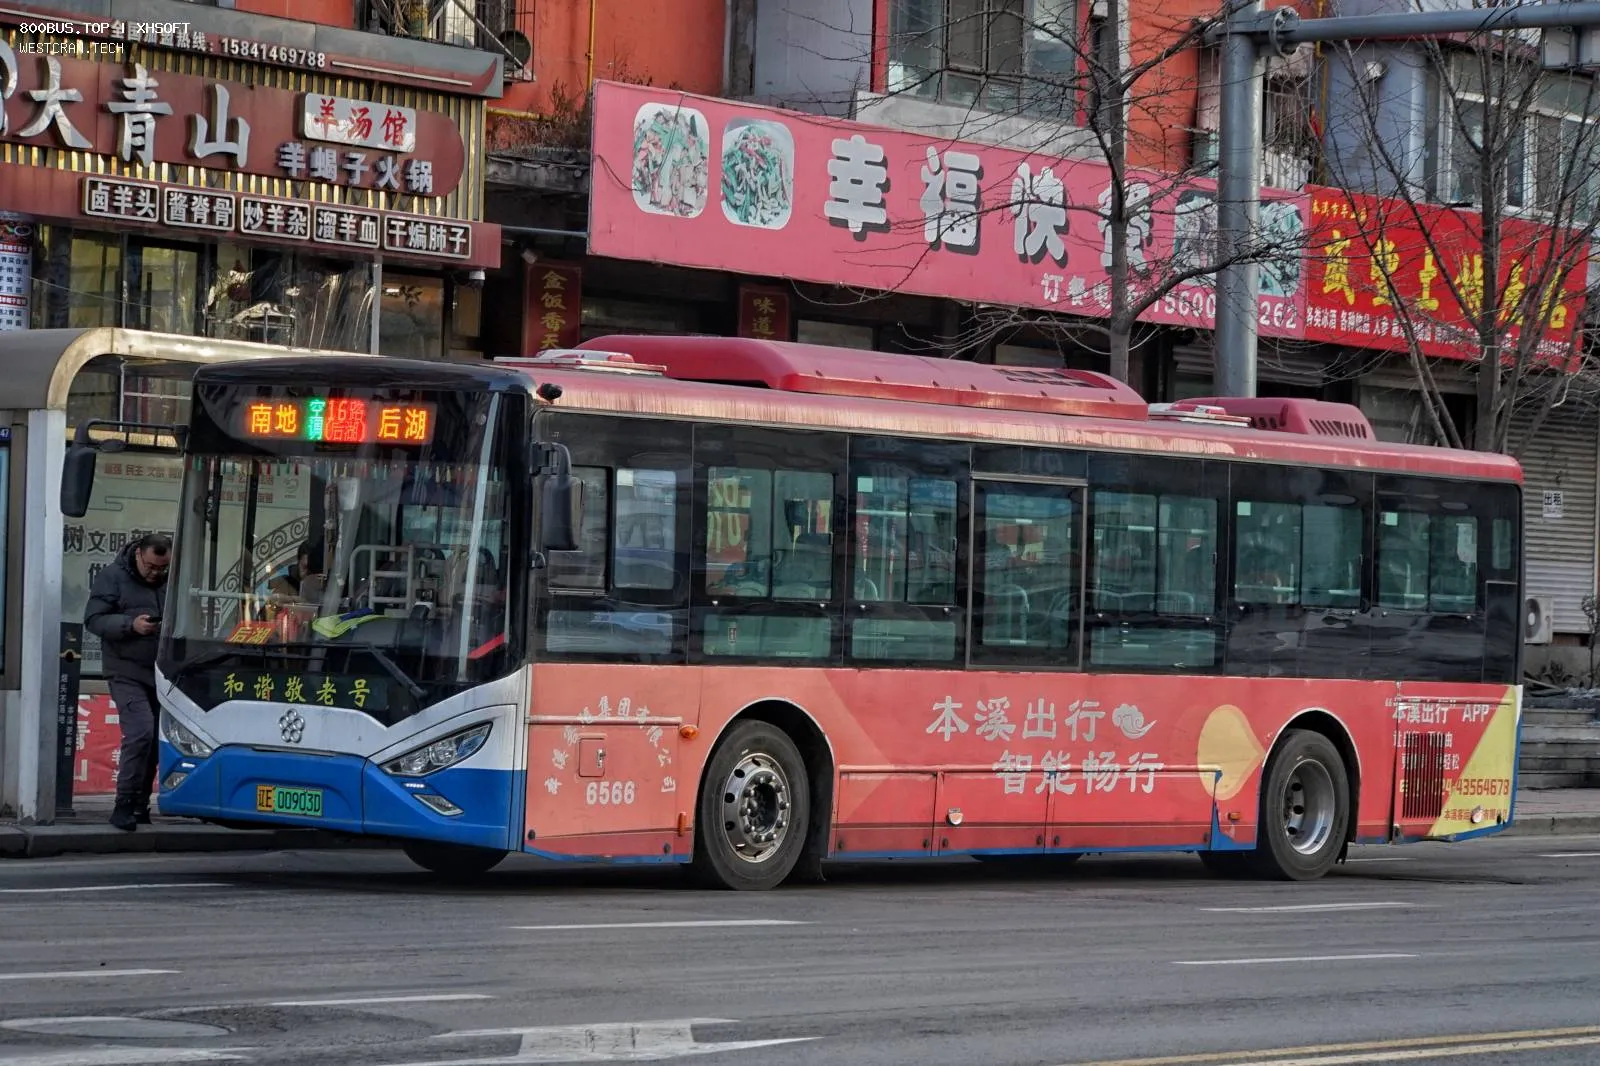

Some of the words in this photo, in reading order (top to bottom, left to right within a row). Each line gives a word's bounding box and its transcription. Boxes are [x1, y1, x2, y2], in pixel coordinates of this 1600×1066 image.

[18, 56, 250, 168] 大青山
[312, 97, 408, 147] 羊汤馆
[278, 141, 434, 194] 羊蝎子火锅
[89, 182, 157, 219] 卤羊头
[166, 190, 234, 228] 酱脊骨
[243, 201, 309, 237] 炒羊杂
[824, 133, 1153, 273] 幸福快餐
[317, 210, 379, 244] 溜羊血
[387, 219, 468, 254] 干煸肺子
[752, 297, 777, 340] 味道
[251, 403, 297, 434] 南地
[309, 399, 326, 441] 空调
[328, 399, 365, 421] 16路
[378, 408, 427, 440] 后湖
[228, 626, 272, 644] 后湖
[224, 673, 370, 707] 和谐敬老号
[926, 695, 1105, 742] 本溪出行
[1462, 703, 1490, 722] APP
[992, 749, 1164, 795] 智能畅行
[586, 780, 635, 805] 6566
